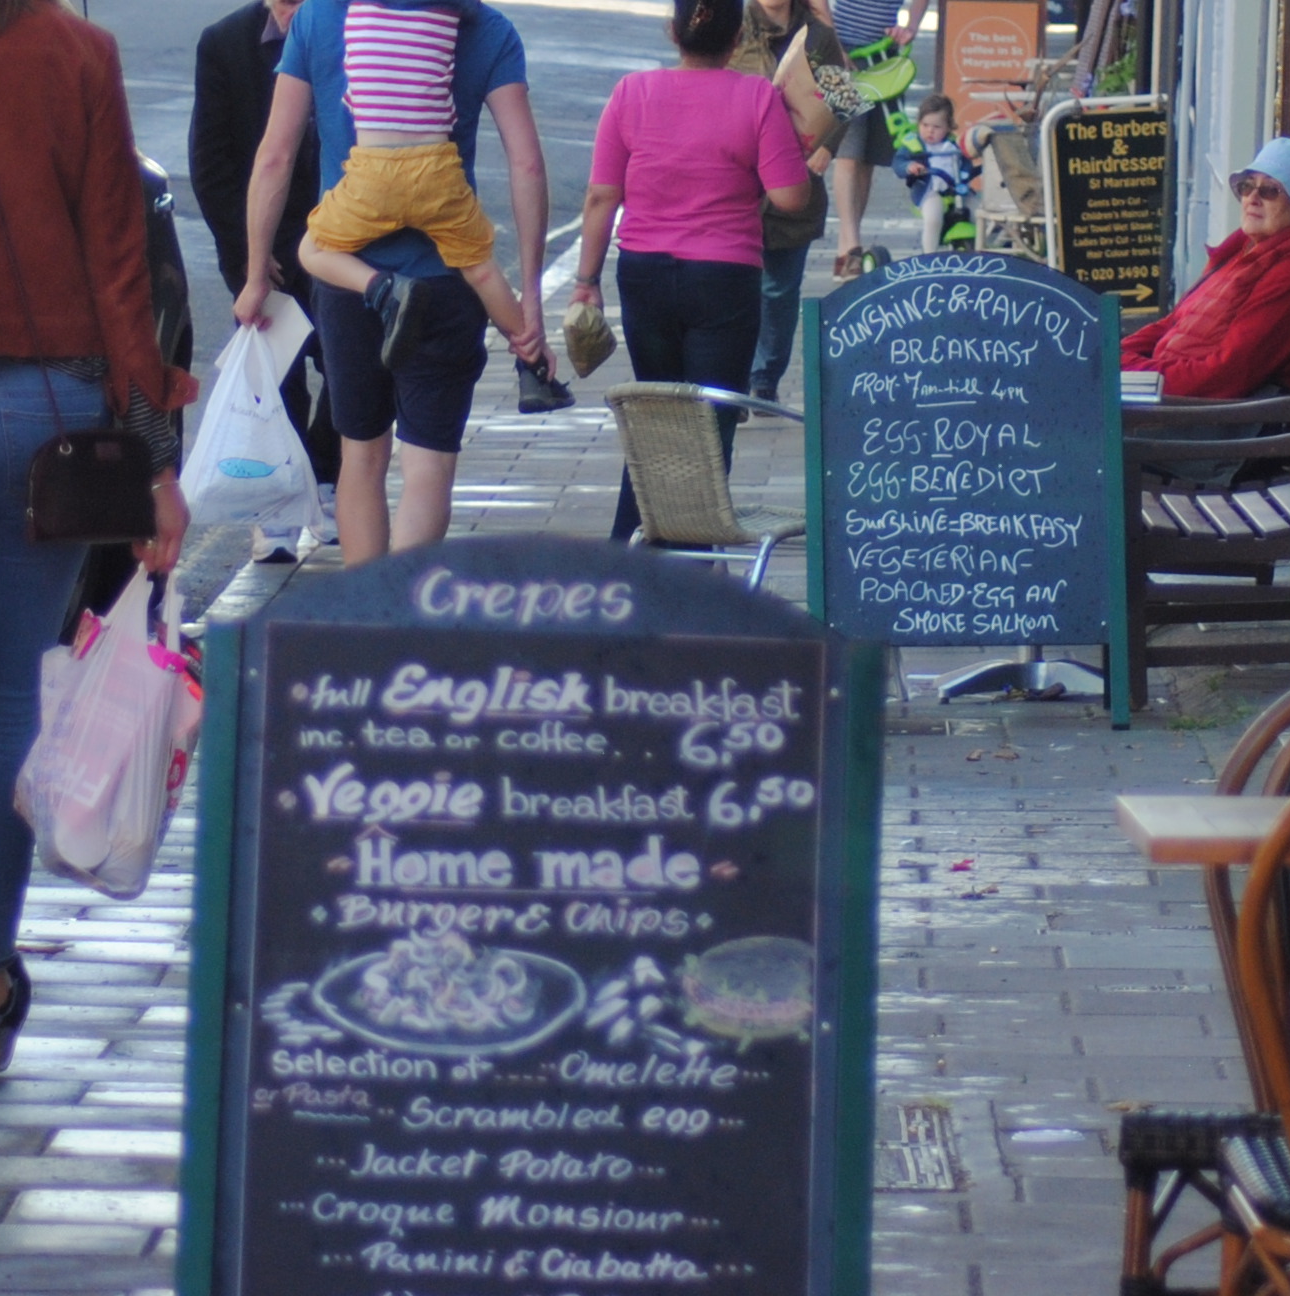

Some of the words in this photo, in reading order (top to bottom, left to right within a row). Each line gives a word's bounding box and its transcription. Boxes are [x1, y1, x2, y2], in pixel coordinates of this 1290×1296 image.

[961, 45, 994, 55] coffee
[997, 46, 1008, 55] in
[969, 32, 989, 42] The
[993, 33, 1017, 43] best
[1066, 123, 1098, 141] The
[1102, 120, 1167, 139] Barbers
[1112, 139, 1129, 155] &
[1091, 267, 1115, 281] 020
[890, 335, 1038, 367] BREAKFAST
[416, 566, 636, 628] Crepes
[1026, 579, 1067, 603] AN
[893, 607, 966, 634] SMOKE
[310, 675, 371, 713] full
[381, 664, 594, 722] English
[603, 674, 804, 722] breakfast
[362, 716, 435, 748] tea
[445, 730, 481, 750] or
[304, 762, 485, 826] Veggie
[501, 774, 696, 823] breakfast
[352, 828, 515, 889] Home
[535, 834, 702, 890] made
[336, 894, 515, 942] Burger
[271, 1049, 439, 1081] Selection
[283, 1082, 371, 1107] Pasta
[401, 1096, 625, 1132] Scrambled
[641, 1105, 711, 1135] egg
[349, 1143, 489, 1180] Jacket
[498, 1149, 634, 1181] Potato
[311, 1193, 457, 1238] Croque
[360, 1241, 497, 1277] Panini
[539, 1248, 709, 1282] Ciabatta
